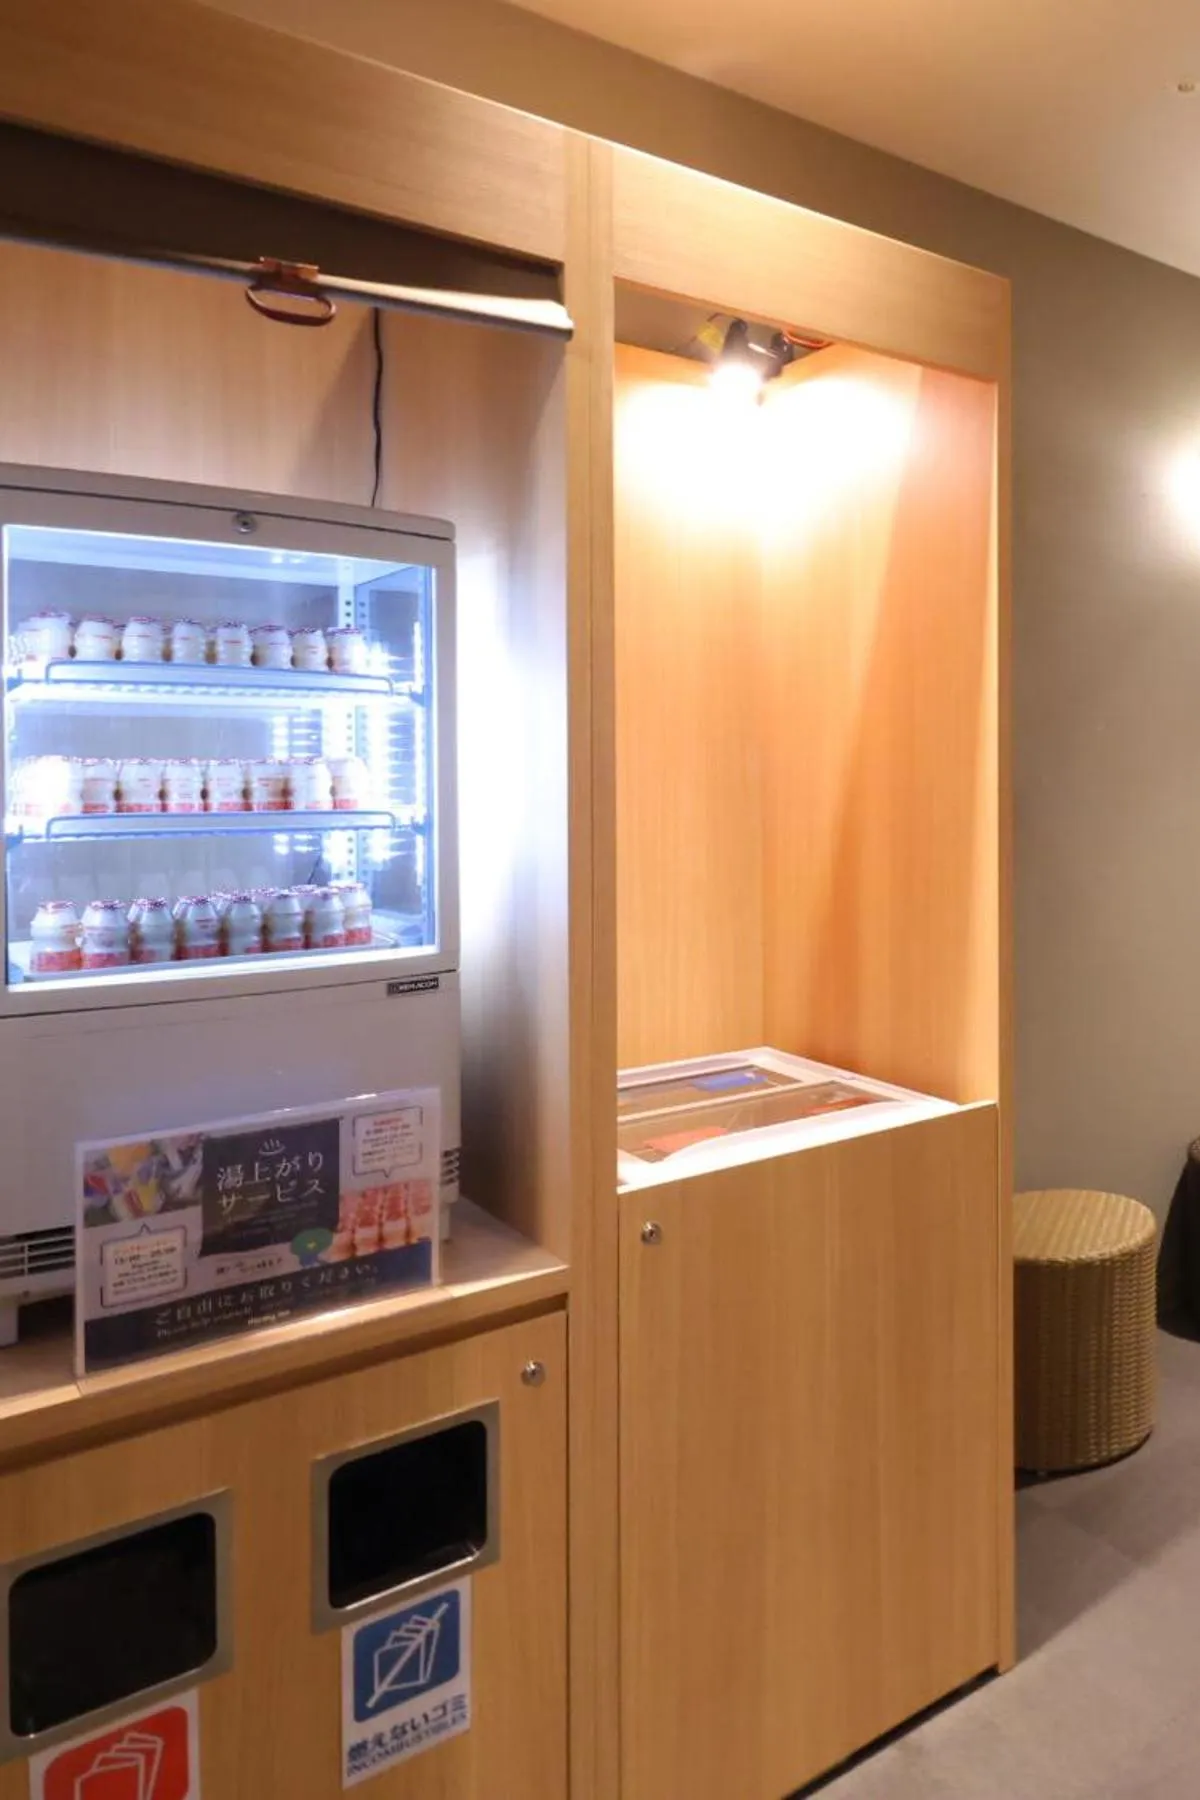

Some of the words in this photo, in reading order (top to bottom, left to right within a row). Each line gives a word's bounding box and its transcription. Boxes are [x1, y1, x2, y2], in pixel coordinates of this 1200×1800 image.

[217, 1151, 324, 1191] 湯上がり
[218, 1179, 327, 1215] サービス
[347, 1693, 467, 1762] 燃えないゴミ
